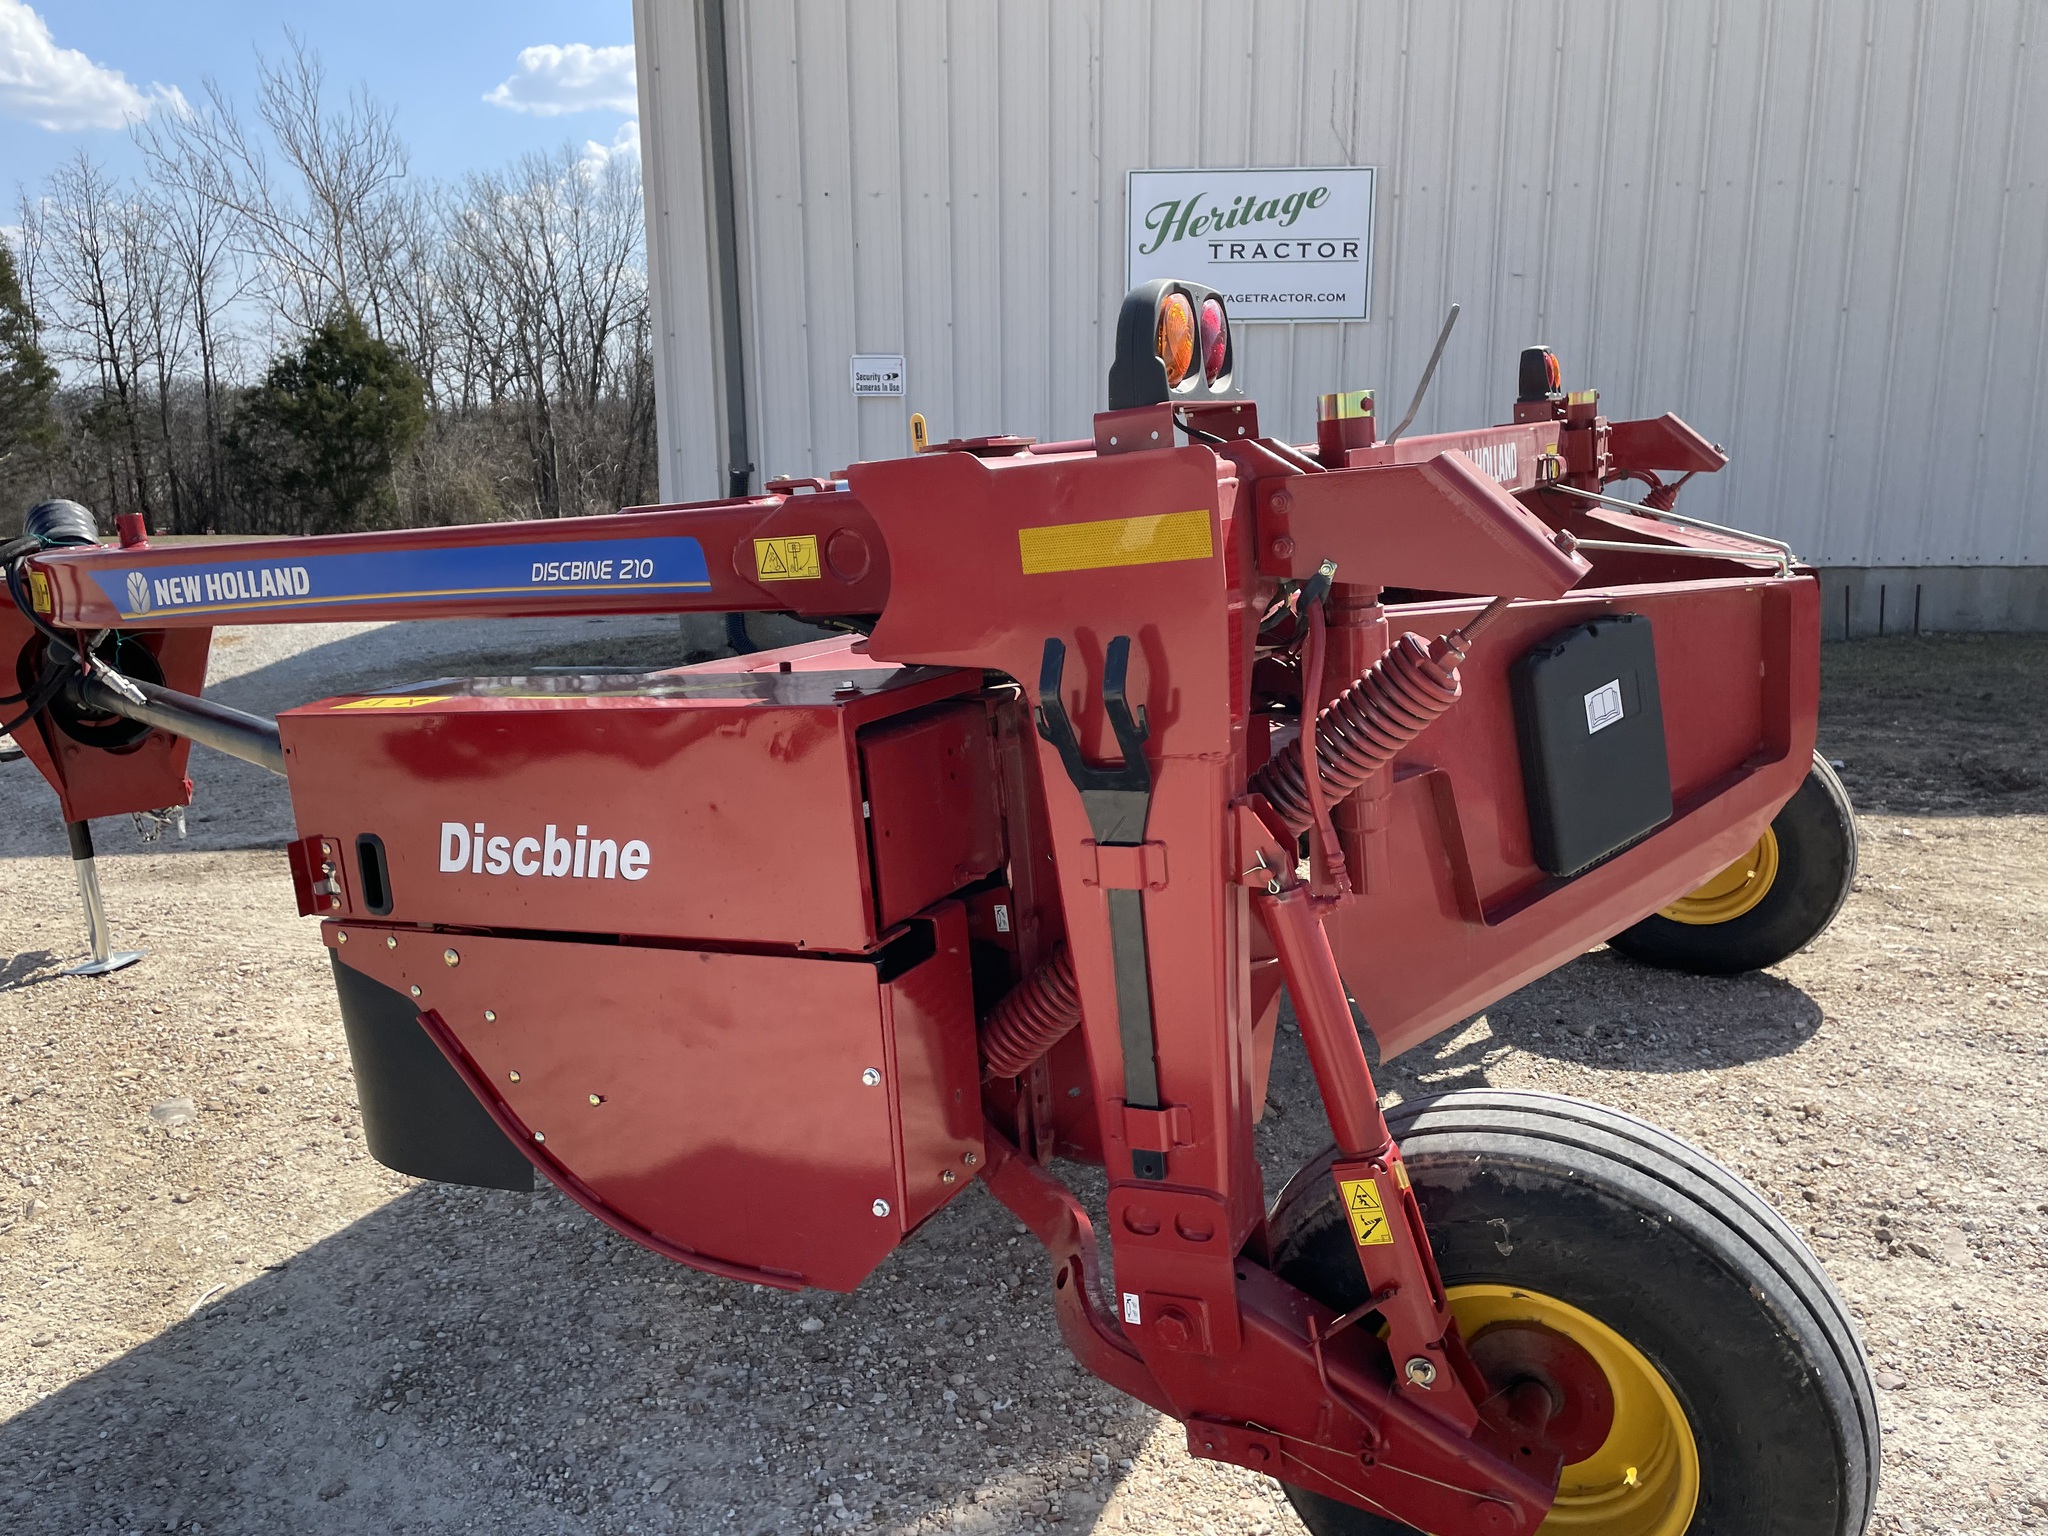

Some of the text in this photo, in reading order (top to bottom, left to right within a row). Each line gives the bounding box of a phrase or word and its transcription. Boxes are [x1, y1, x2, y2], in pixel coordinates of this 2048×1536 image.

[1138, 186, 1331, 255] Heritage
[1208, 242, 1359, 260] TRACTOR
[856, 372, 880, 382] Security
[856, 383, 900, 391] Cameras In Use
[531, 558, 654, 582] DISCBINE 210
[154, 566, 310, 606] NEW HOLLAND
[439, 822, 651, 881] Discbine
